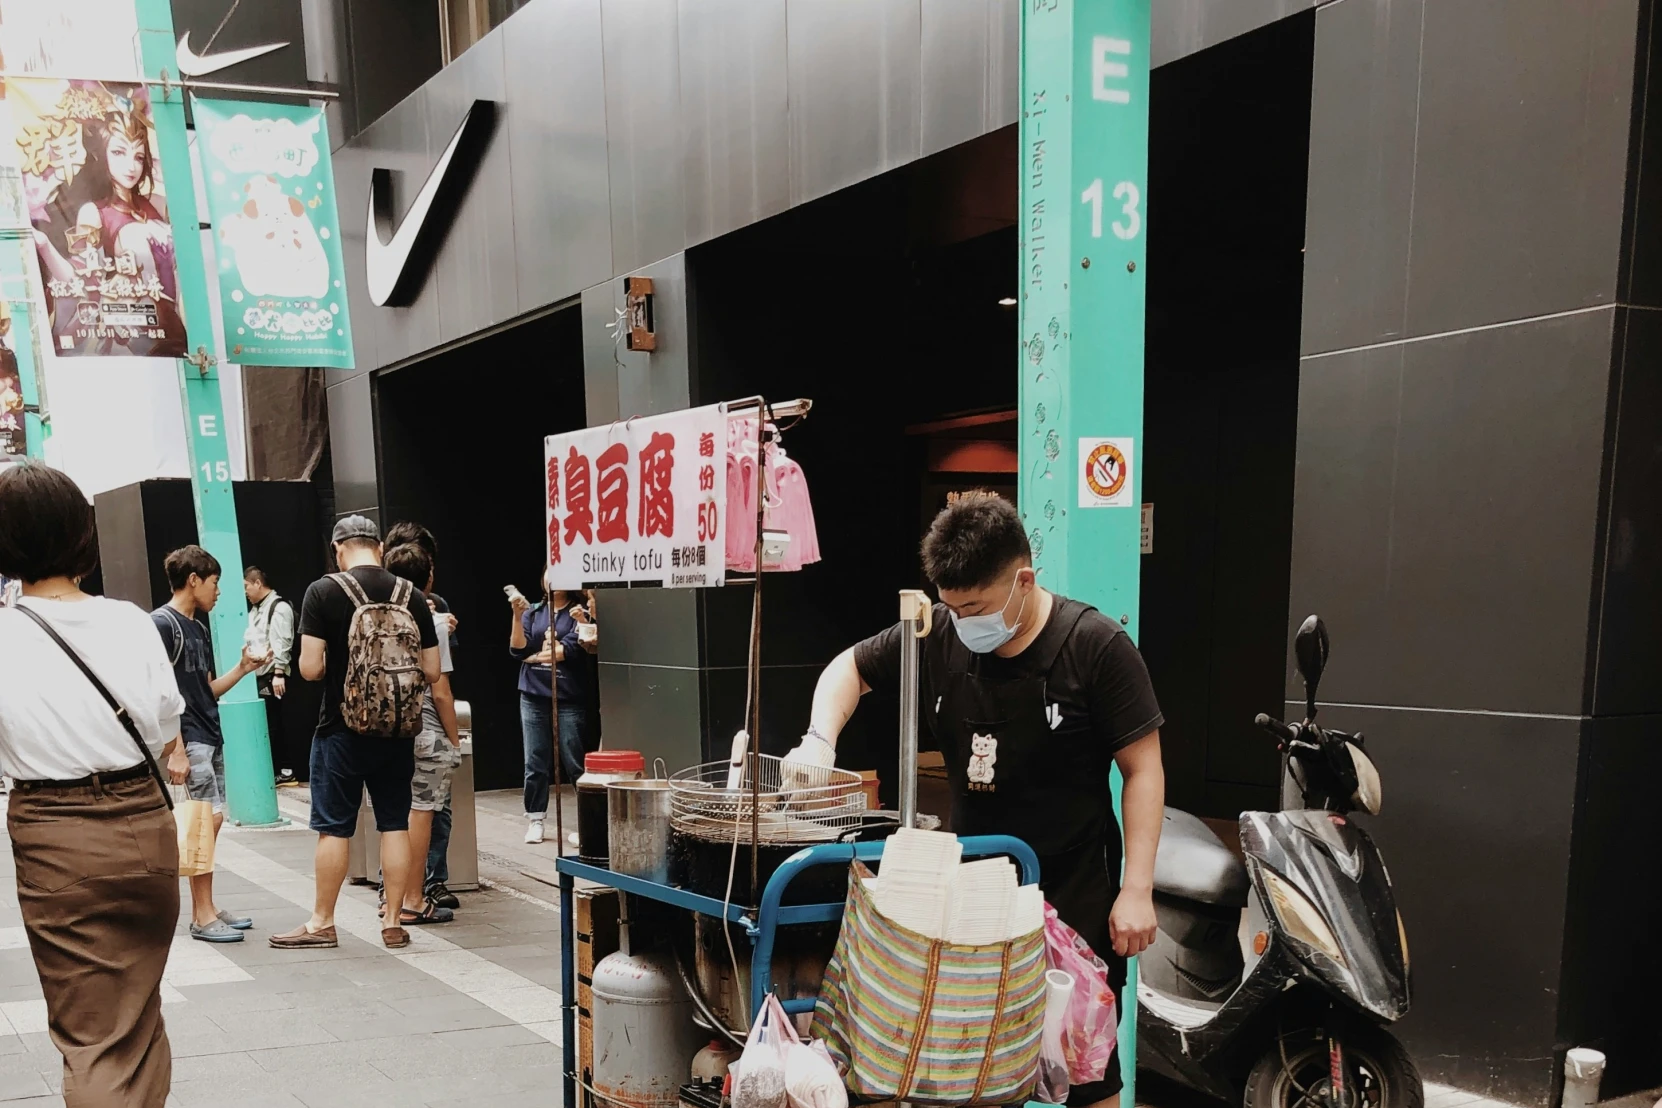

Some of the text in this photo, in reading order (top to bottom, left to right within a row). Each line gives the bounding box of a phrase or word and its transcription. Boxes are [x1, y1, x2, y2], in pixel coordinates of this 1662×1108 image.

[1091, 35, 1131, 104] E
[1081, 178, 1140, 240] 13
[1031, 199, 1046, 291] Walker
[199, 415, 218, 436] E
[201, 461, 229, 482] 15
[563, 432, 675, 546] 臭豆腐
[698, 432, 717, 542] 每份 50
[582, 548, 662, 577] Stinky tofu
[671, 545, 706, 568] 每份8個
[675, 574, 686, 586] per
[686, 572, 706, 585] serving
